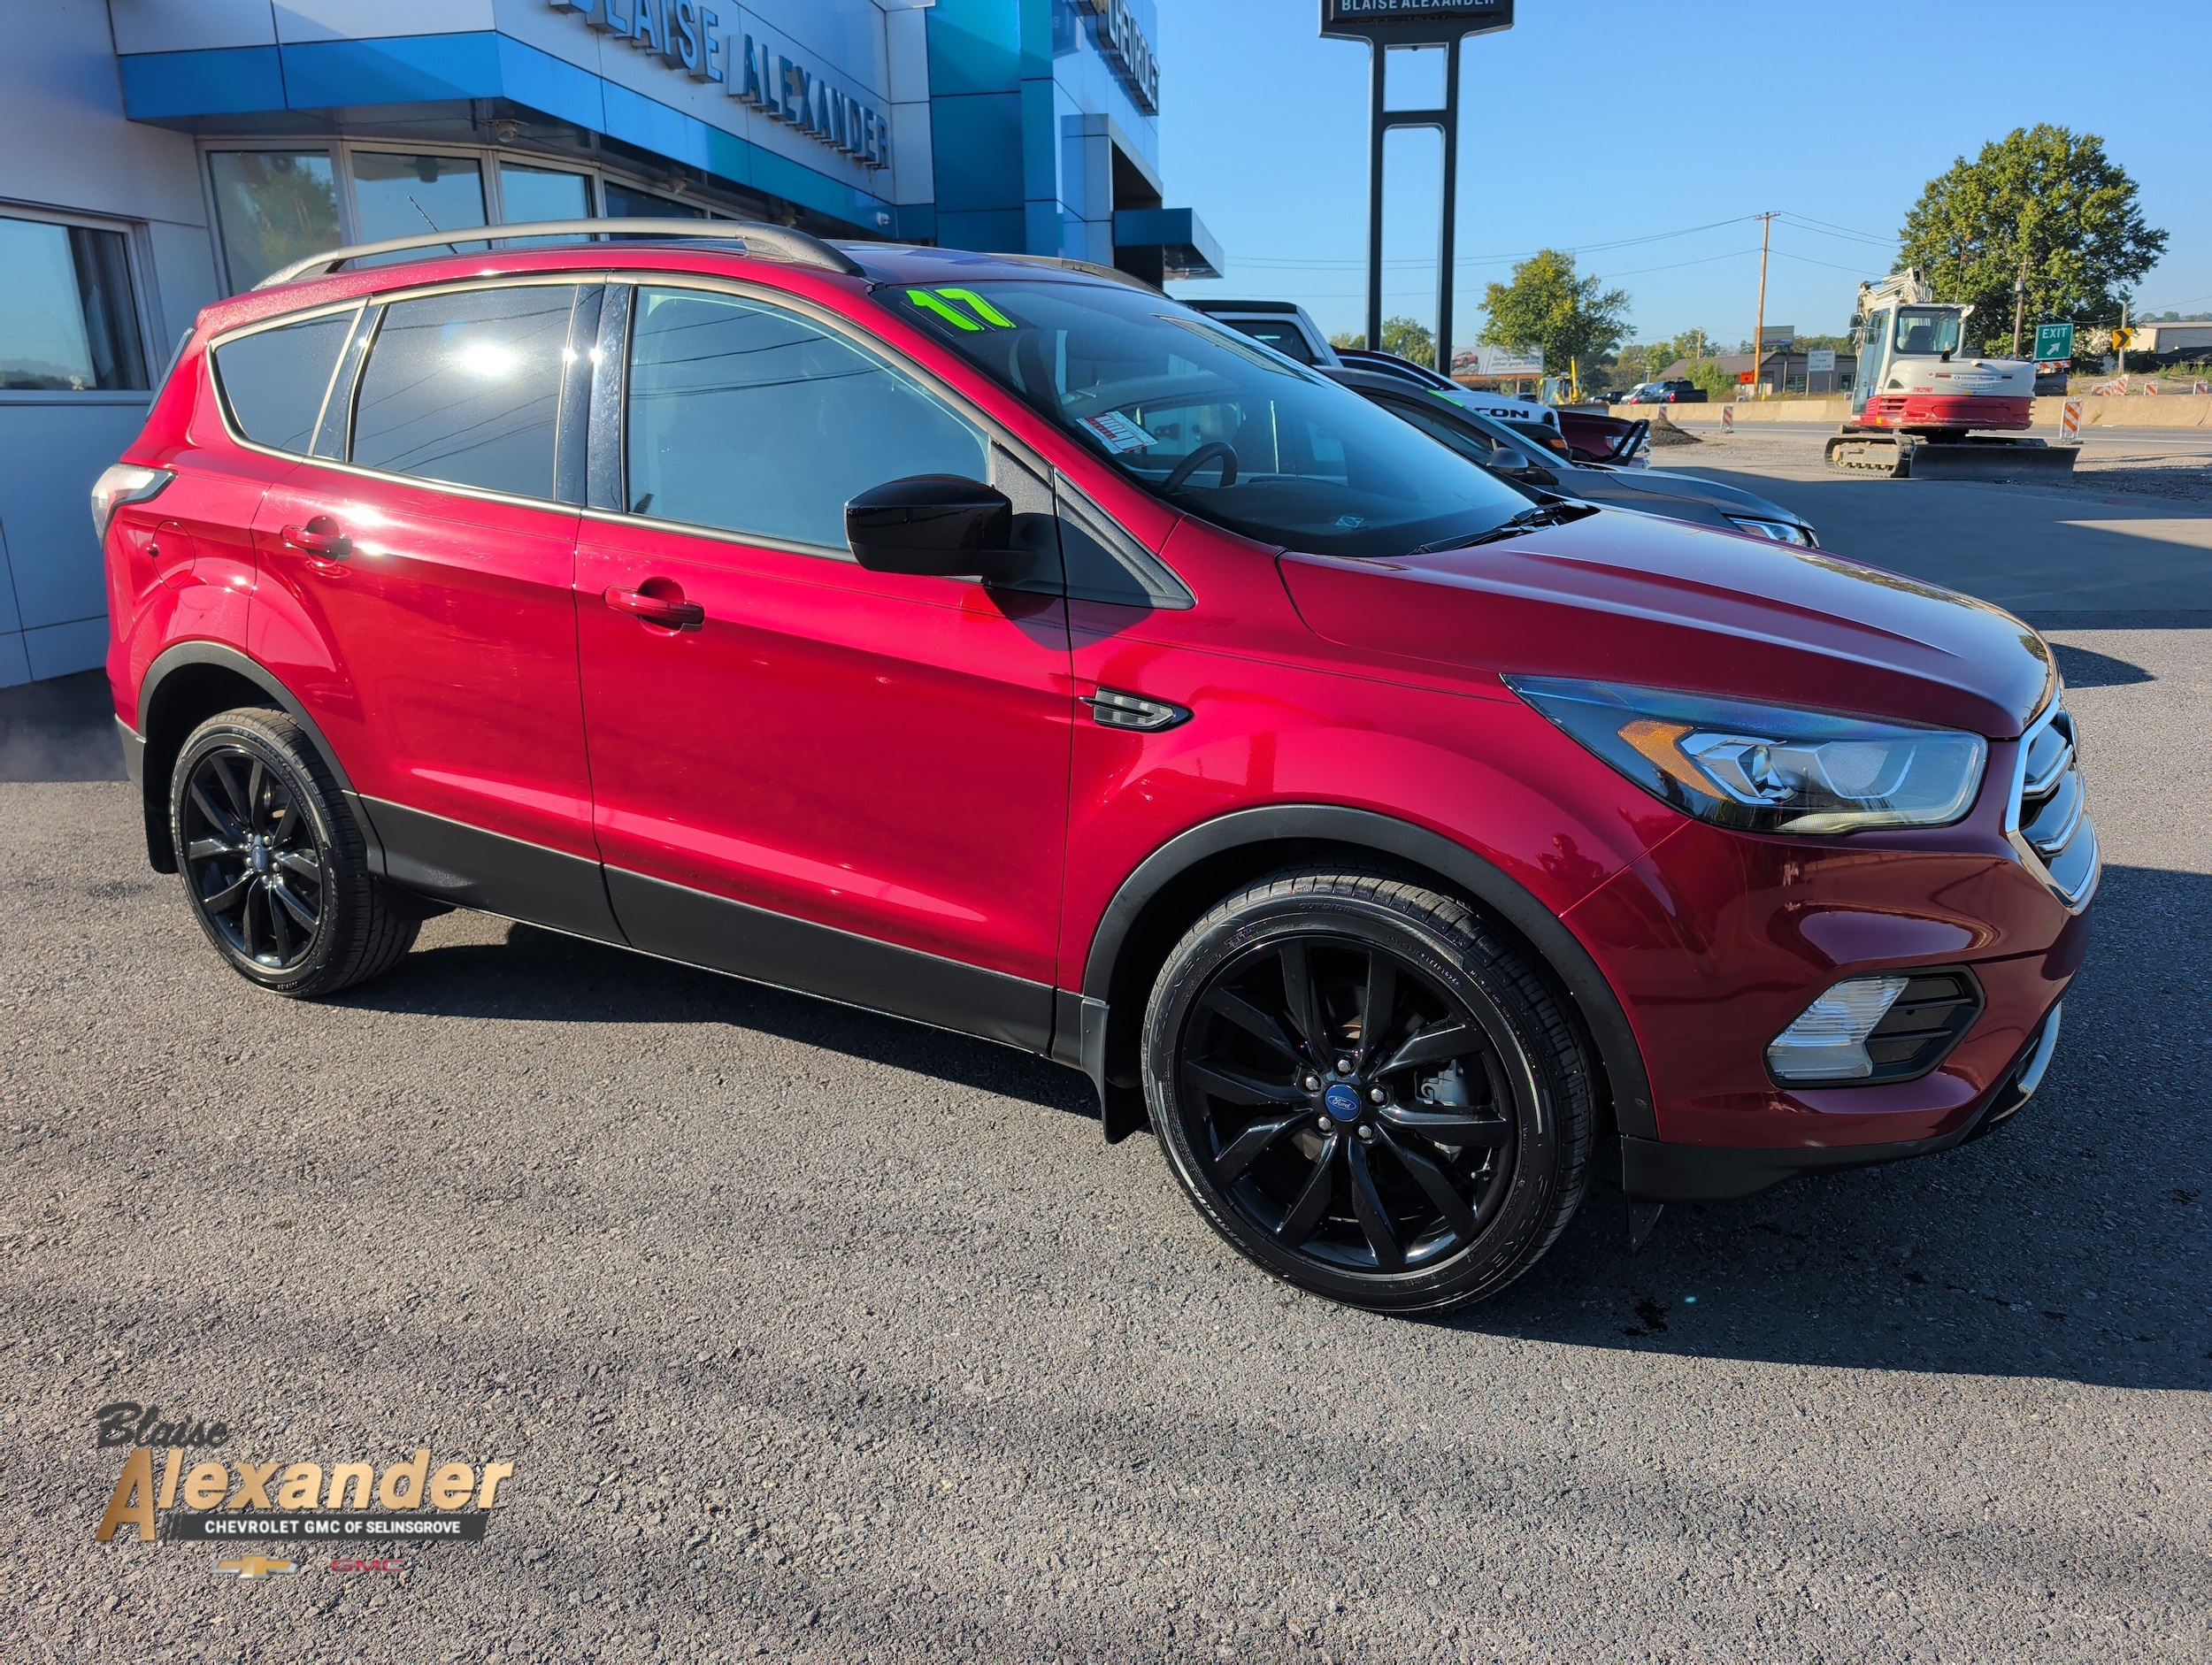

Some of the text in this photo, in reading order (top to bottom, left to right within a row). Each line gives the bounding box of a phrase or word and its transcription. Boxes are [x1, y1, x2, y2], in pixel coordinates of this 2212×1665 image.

[1341, 0, 1398, 11] BLAISE
[550, 0, 889, 169] LAISE ALEXANDER
[905, 288, 1017, 331] 17
[2042, 327, 2068, 339] EXIT
[1332, 1097, 1353, 1109] Ford
